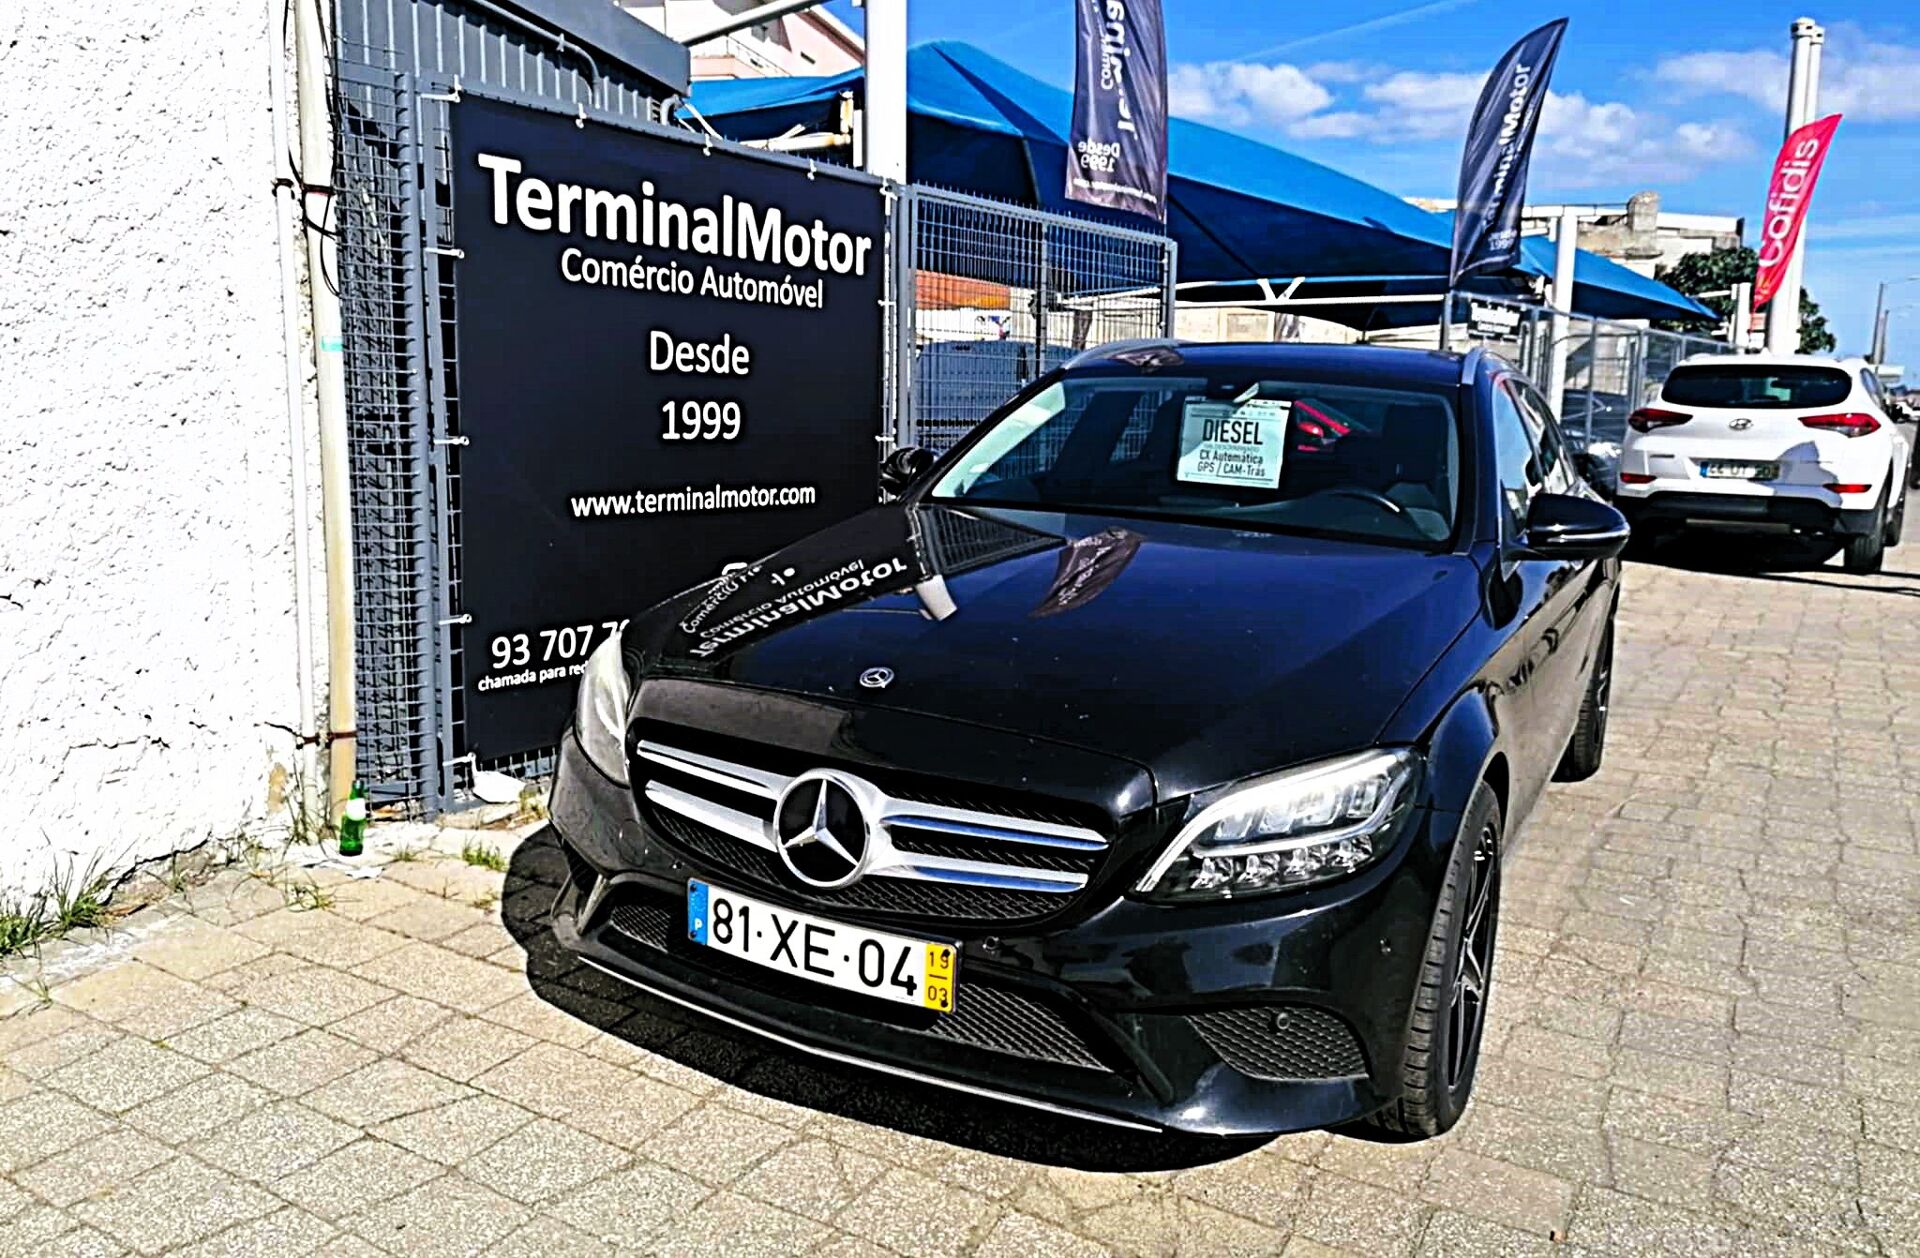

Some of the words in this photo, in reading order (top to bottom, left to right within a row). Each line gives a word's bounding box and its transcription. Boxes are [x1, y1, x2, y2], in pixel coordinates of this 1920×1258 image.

[478, 153, 872, 276] TerminalMotor
[561, 248, 694, 294] Comércio
[700, 266, 823, 309] Automóvel
[650, 330, 750, 375] Desde
[662, 401, 741, 440] 1999
[1202, 418, 1263, 445] DIESEL
[1197, 461, 1215, 473] GPS
[570, 484, 816, 518] www.terminalmotor.com
[491, 634, 531, 669] 93
[539, 625, 594, 661] 707
[477, 668, 537, 692] chamada
[539, 666, 567, 684] para
[694, 918, 703, 931] P
[929, 950, 950, 969] 19
